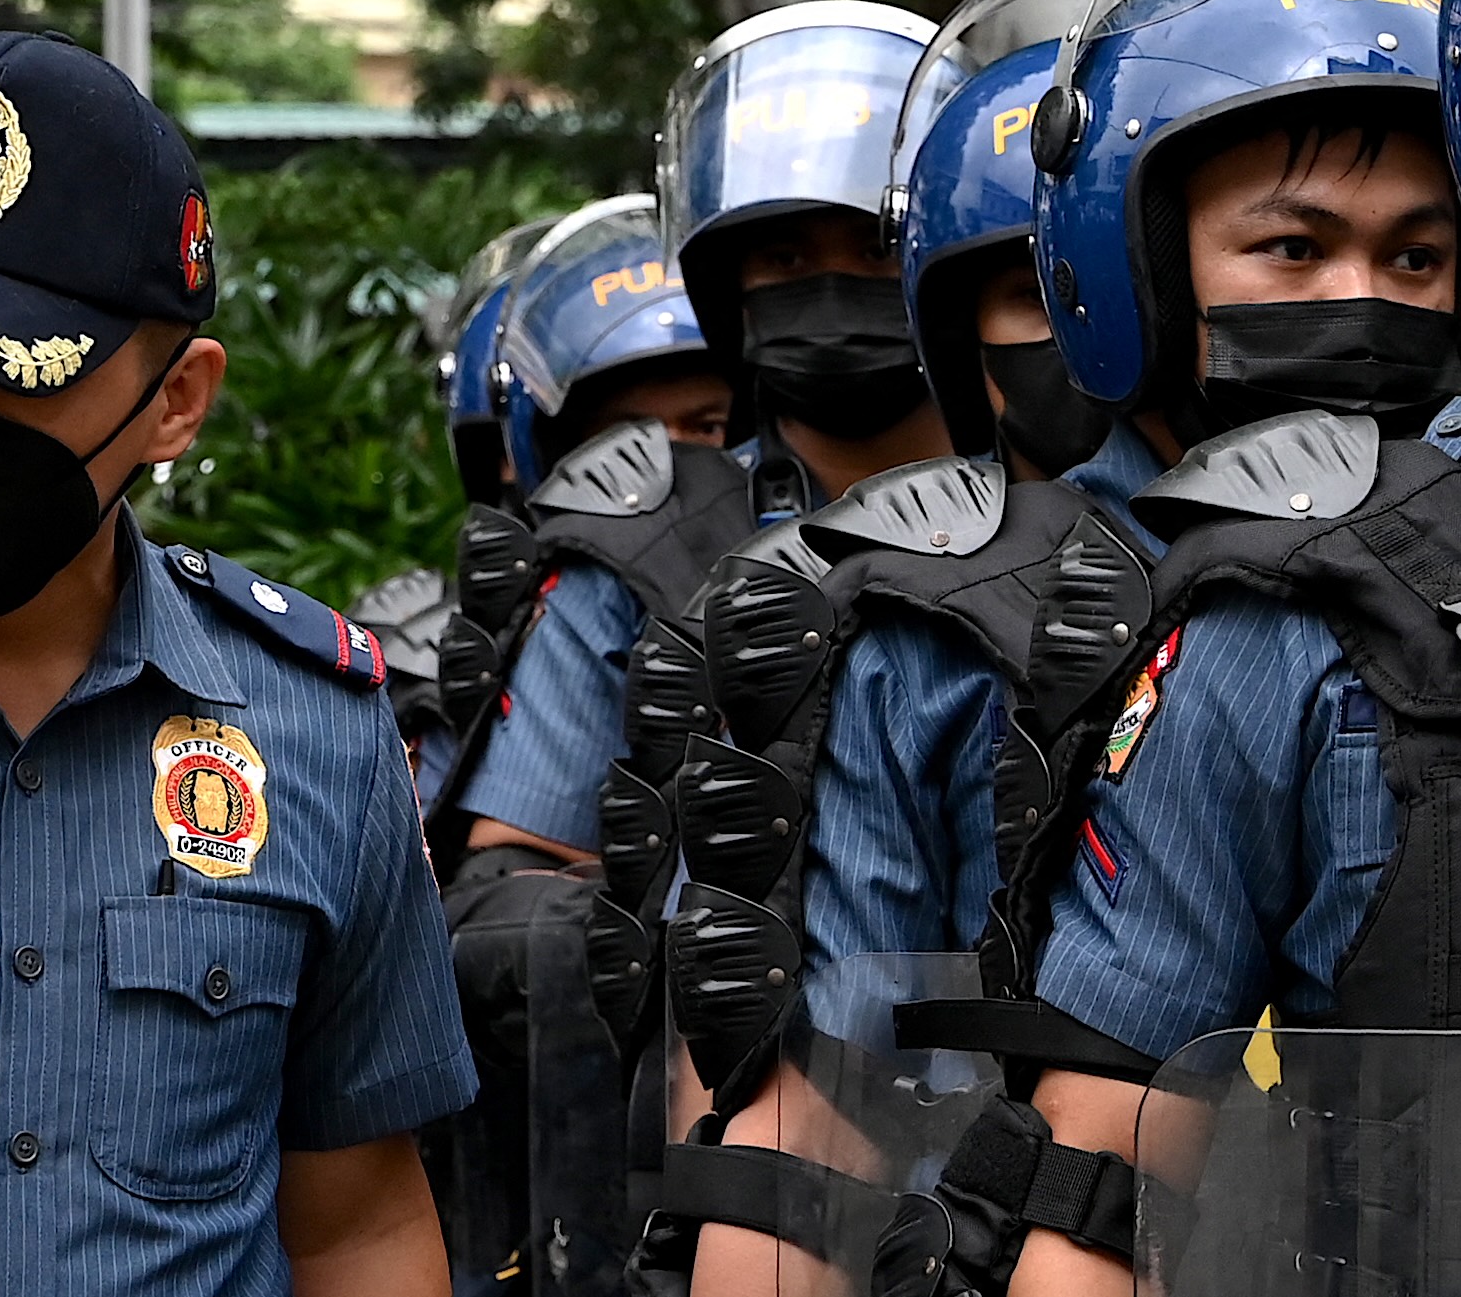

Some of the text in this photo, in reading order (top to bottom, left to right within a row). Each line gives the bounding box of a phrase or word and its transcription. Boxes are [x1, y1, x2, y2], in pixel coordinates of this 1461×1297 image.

[171, 740, 248, 772] OFFICER
[166, 756, 255, 836] PHILIPPINE NATIONAL POLICE
